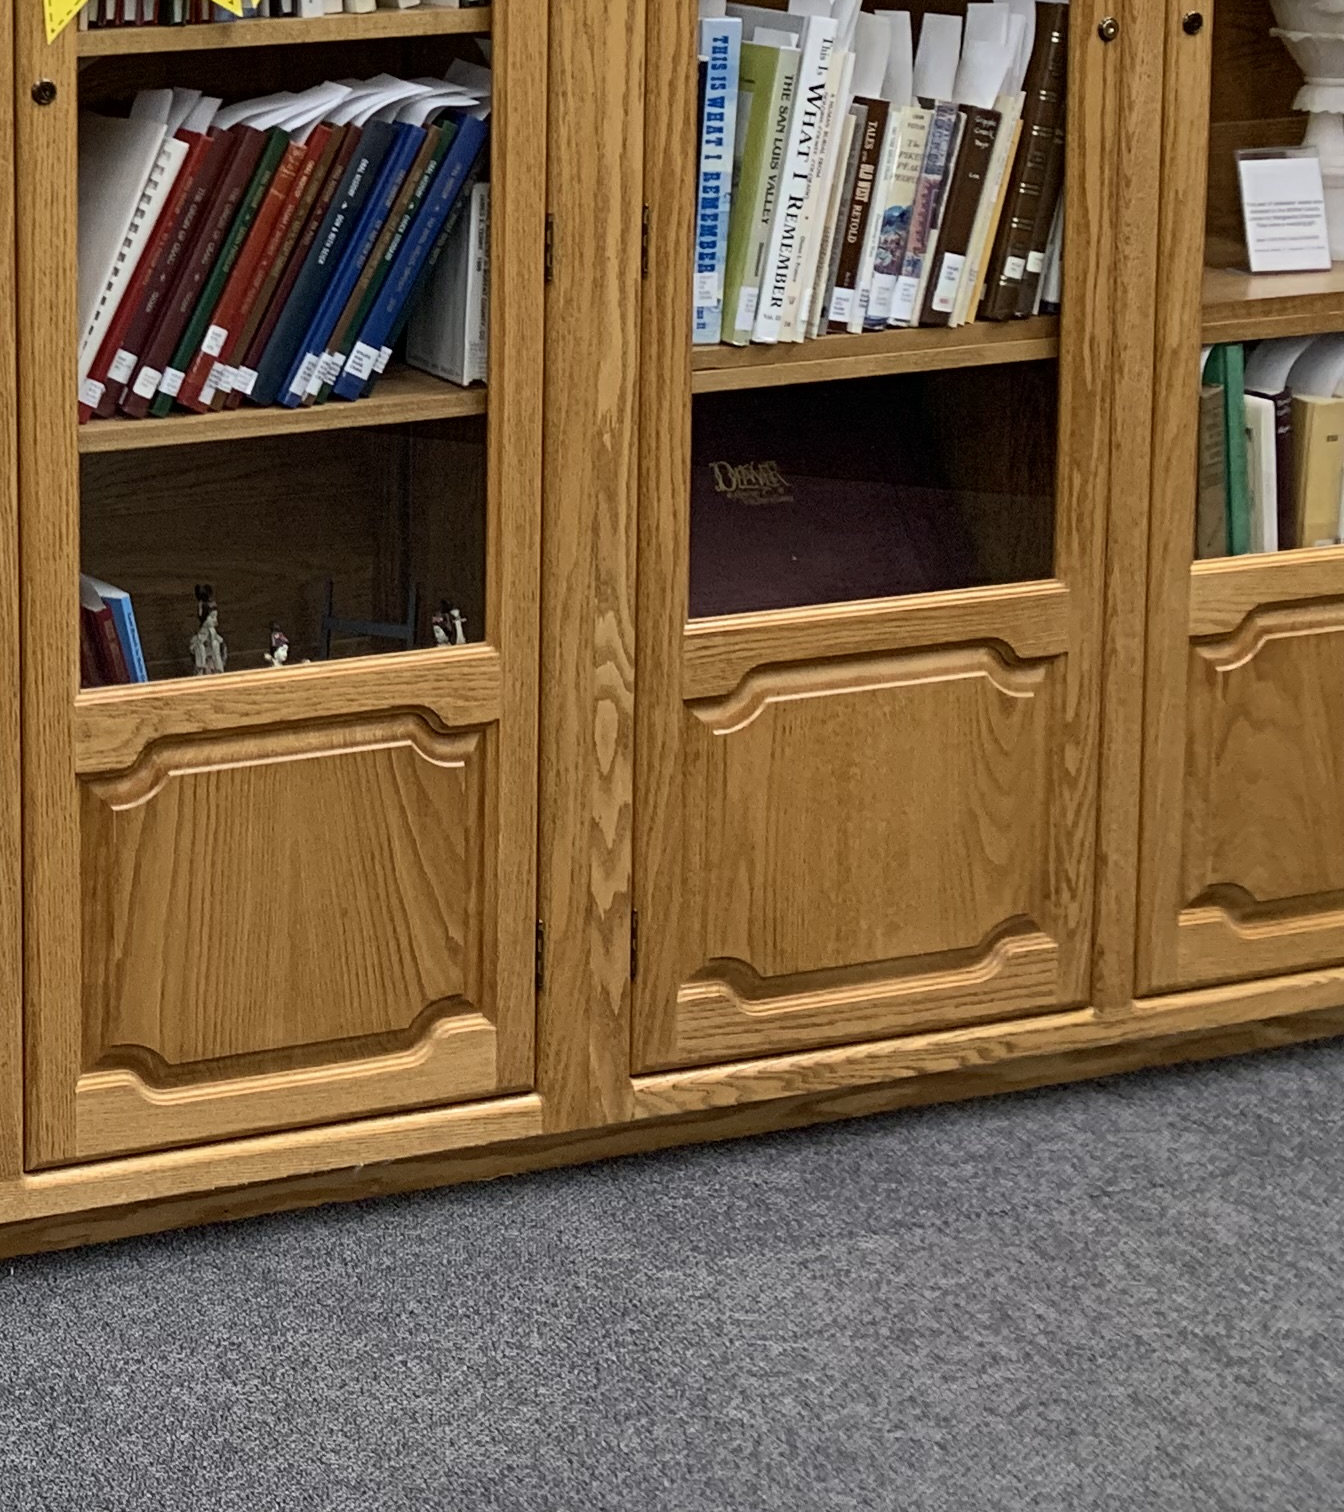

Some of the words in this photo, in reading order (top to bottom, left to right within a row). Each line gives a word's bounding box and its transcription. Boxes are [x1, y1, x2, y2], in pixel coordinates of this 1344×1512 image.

[711, 36, 728, 71] THIS
[818, 36, 834, 64] This
[710, 76, 725, 90] IS
[779, 74, 794, 103] THE
[706, 96, 725, 147] WHAT
[775, 105, 790, 133] SAN
[797, 83, 826, 166] WHAT
[864, 121, 878, 150] TALES
[769, 138, 785, 170] LUIS
[859, 163, 874, 179] OLD
[761, 175, 779, 225] VALLEY
[854, 181, 872, 202] WEST
[698, 172, 721, 274] REMEMBER
[847, 205, 862, 243] RETOLD
[770, 196, 805, 308] REMEMBER
